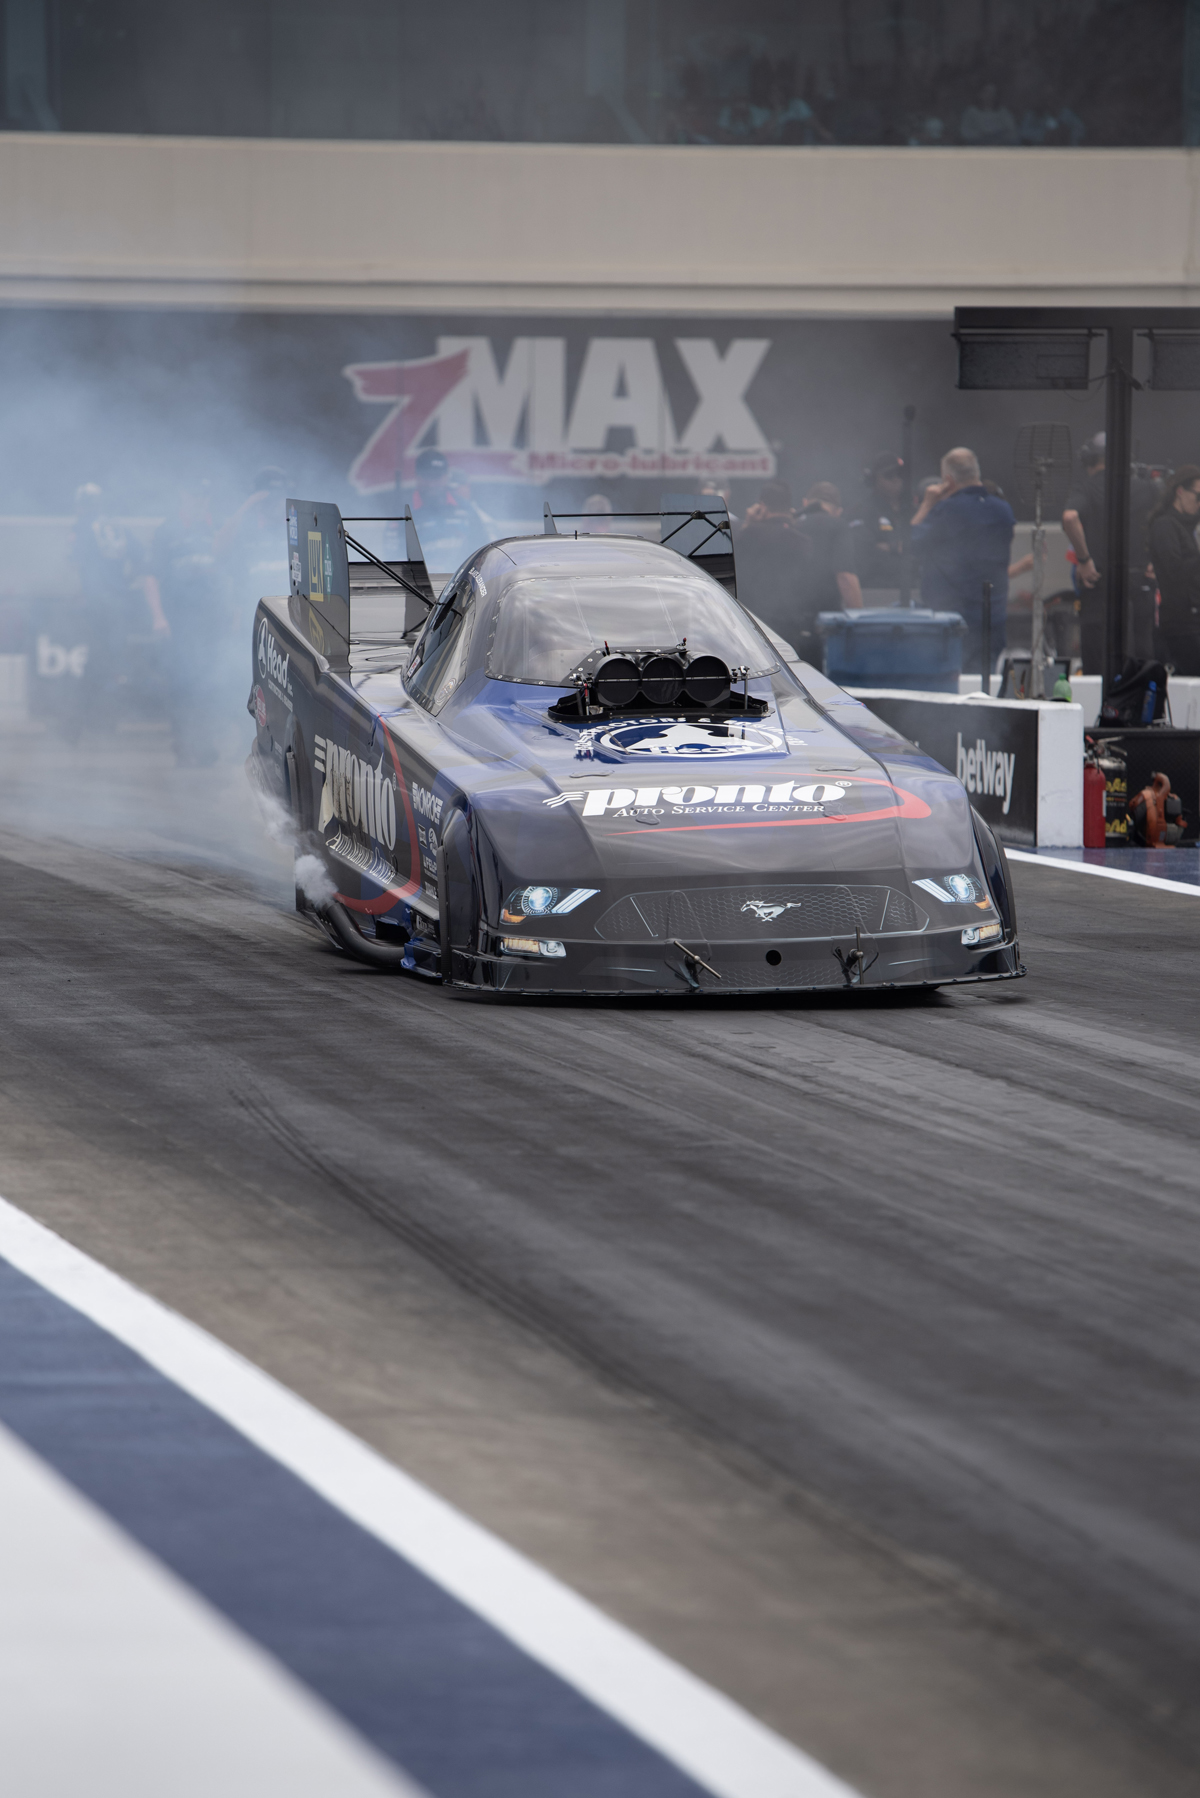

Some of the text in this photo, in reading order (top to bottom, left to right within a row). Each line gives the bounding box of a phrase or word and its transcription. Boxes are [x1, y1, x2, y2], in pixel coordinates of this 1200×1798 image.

[267, 634, 290, 688] Head
[957, 732, 1015, 815] betway
[582, 780, 846, 817] pronto
[612, 803, 825, 818] AUTO SERVICE CENTER
